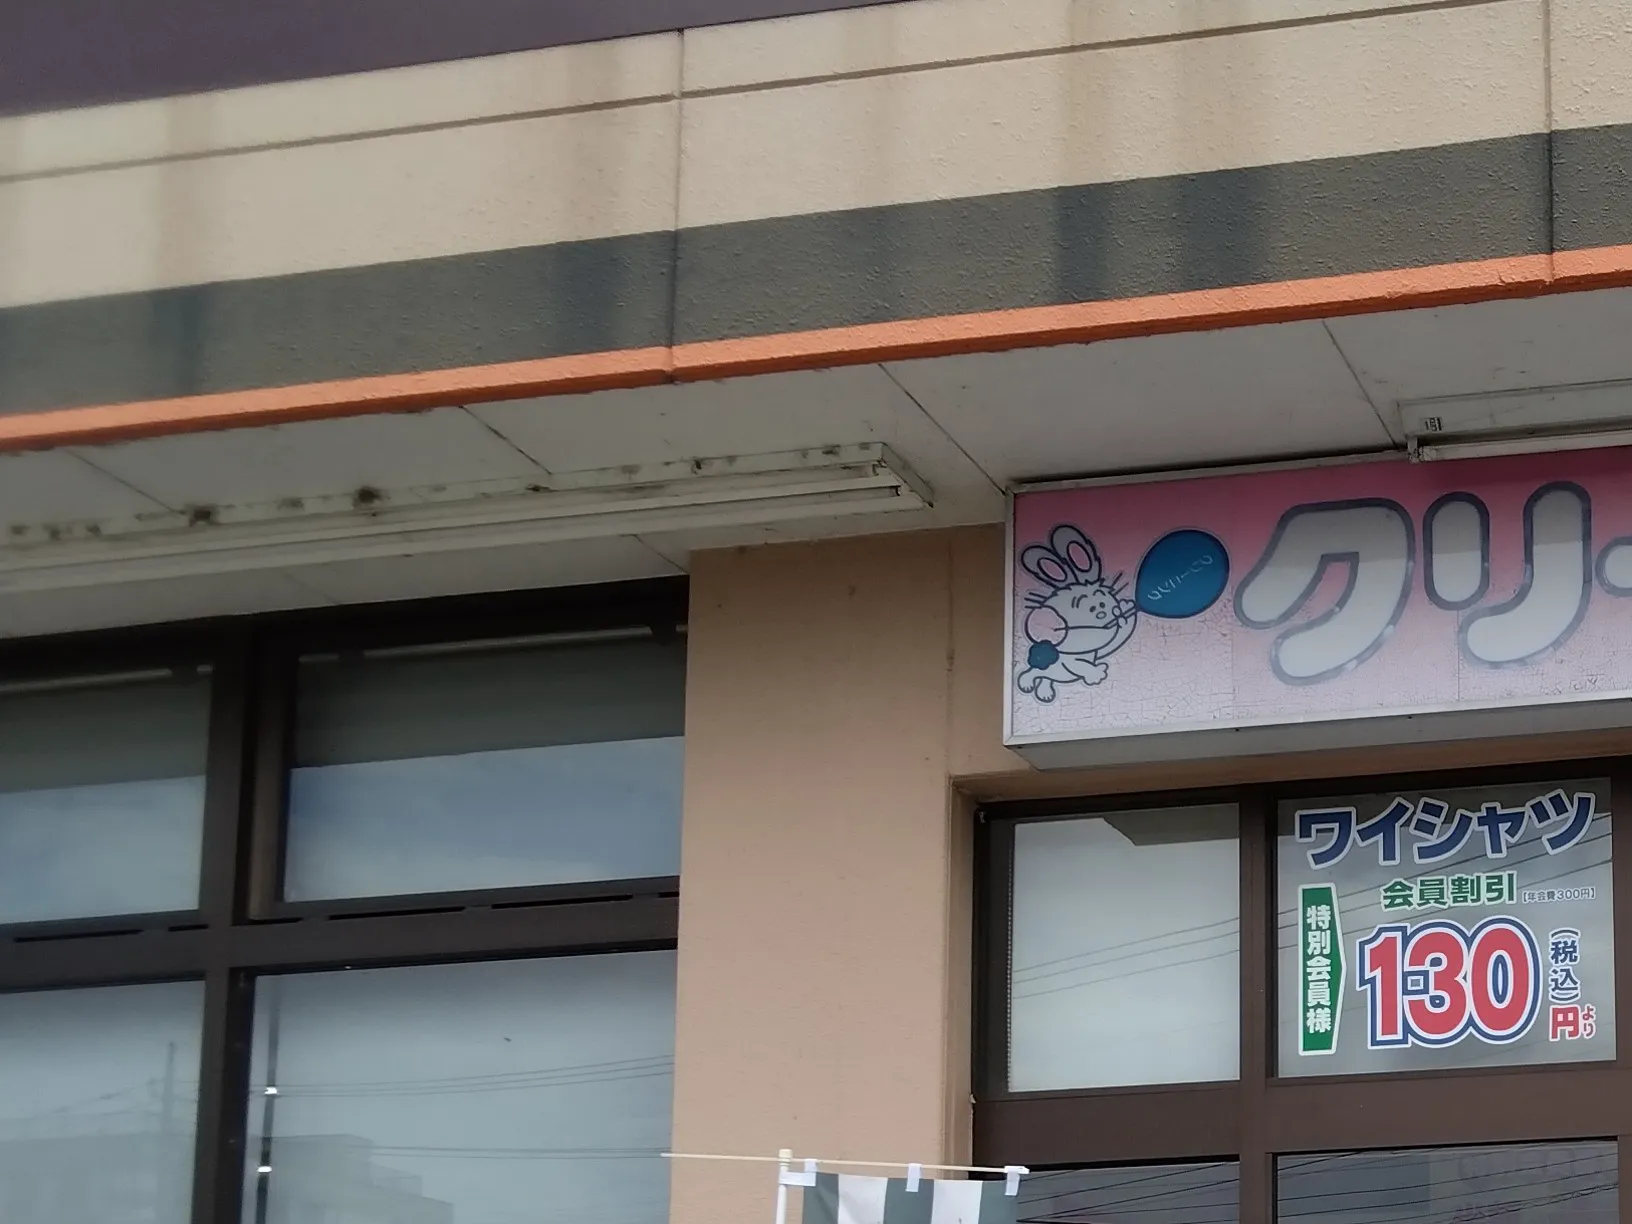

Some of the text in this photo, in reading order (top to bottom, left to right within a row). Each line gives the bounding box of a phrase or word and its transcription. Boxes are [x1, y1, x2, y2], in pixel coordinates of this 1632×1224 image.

[1297, 791, 1595, 867] ワイシャツ
[1383, 873, 1516, 909] 会員割引
[1306, 905, 1332, 1034] 特別会員様
[1362, 921, 1538, 1043] 130
[1550, 1006, 1579, 1040] 円
